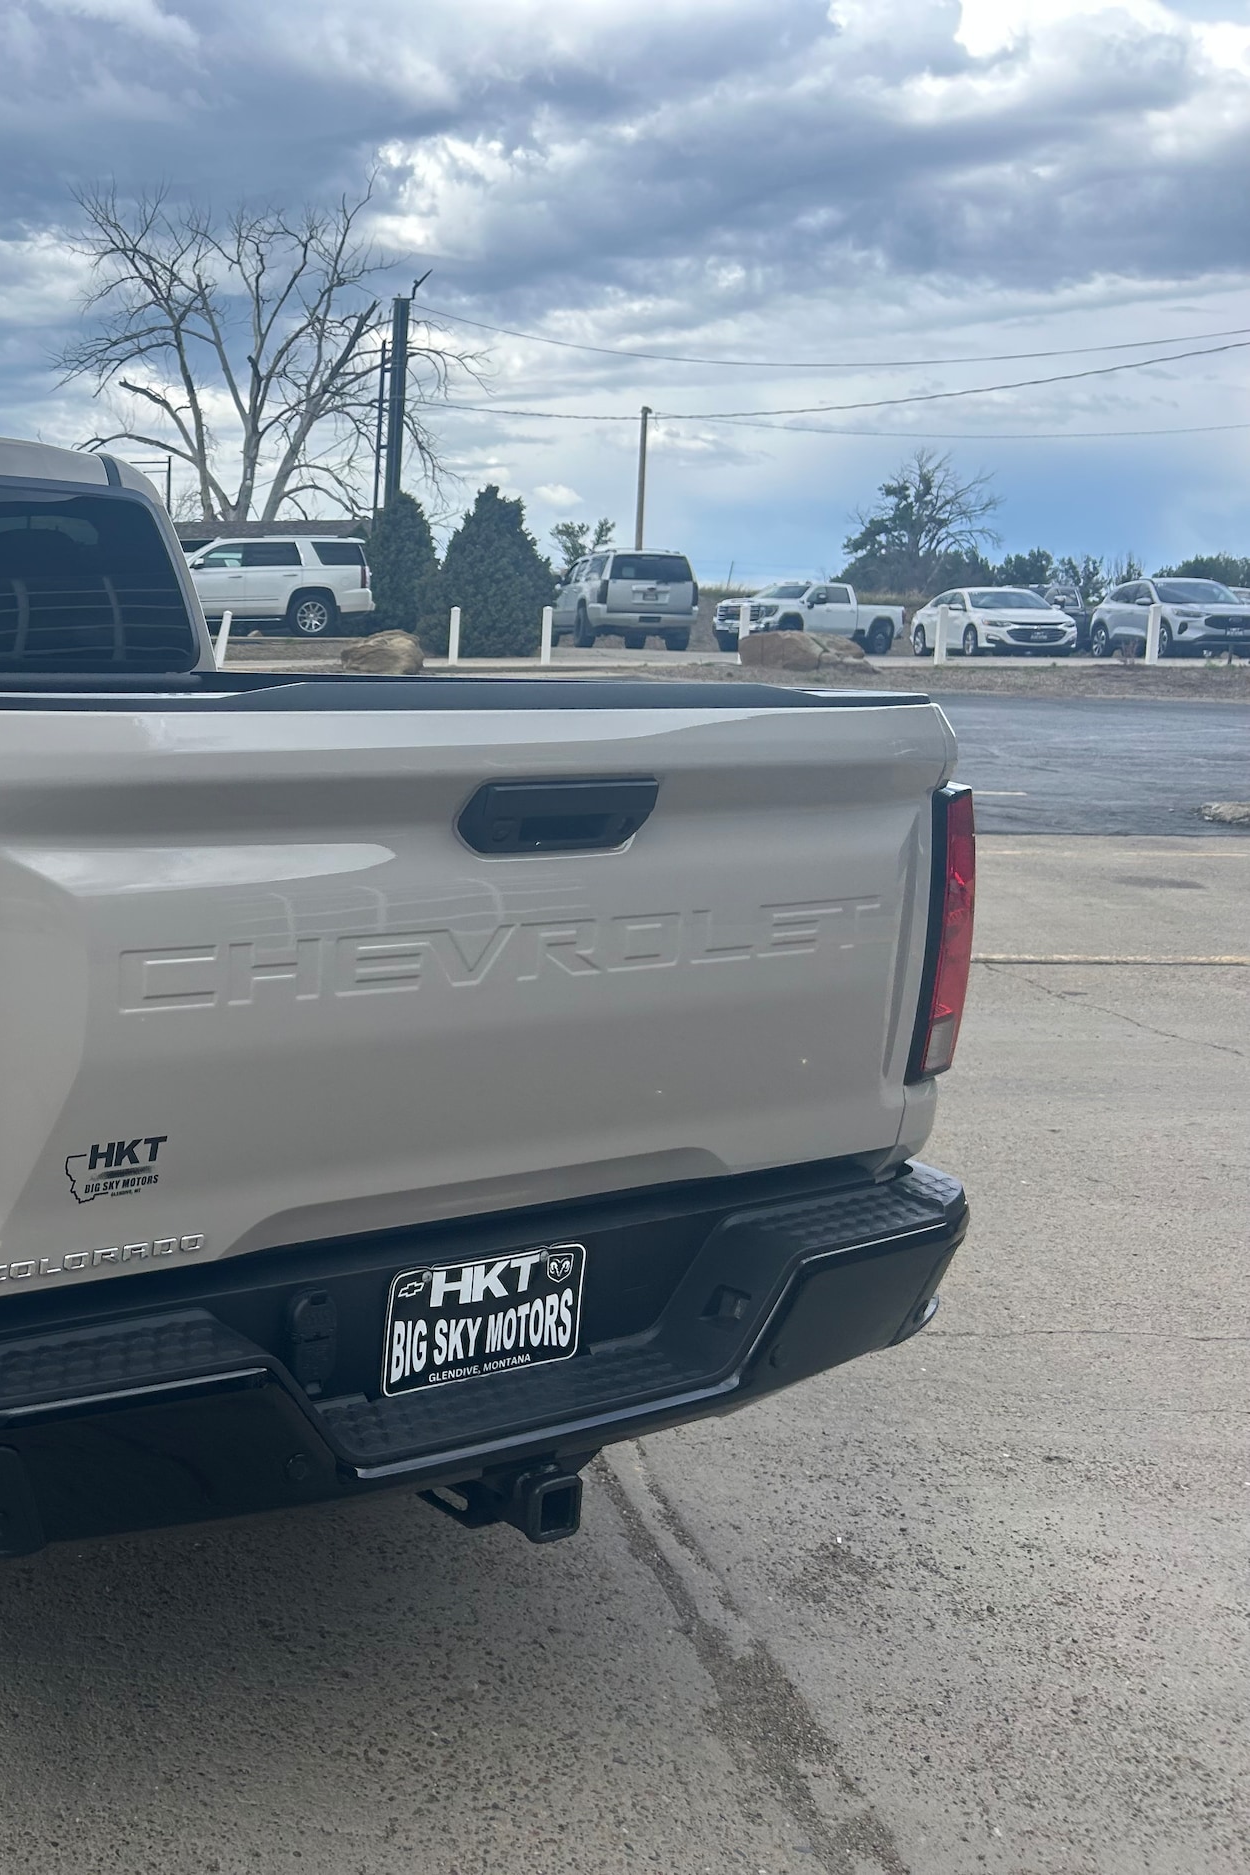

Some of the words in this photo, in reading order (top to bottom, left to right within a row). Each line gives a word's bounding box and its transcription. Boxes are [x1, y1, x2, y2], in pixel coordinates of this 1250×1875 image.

[118, 894, 883, 1014] CHEVROLET
[88, 1135, 168, 1170] HKT
[84, 1182, 101, 1194] BIG
[102, 1179, 121, 1191] SKY
[121, 1174, 159, 1188] MOTORS
[429, 1253, 540, 1308] HKT
[390, 1319, 428, 1384] BIG
[433, 1316, 483, 1366] SKY
[484, 1287, 574, 1354] MOTORS
[428, 1364, 481, 1383] GLENDIVE,
[482, 1353, 532, 1373] MONTANA
